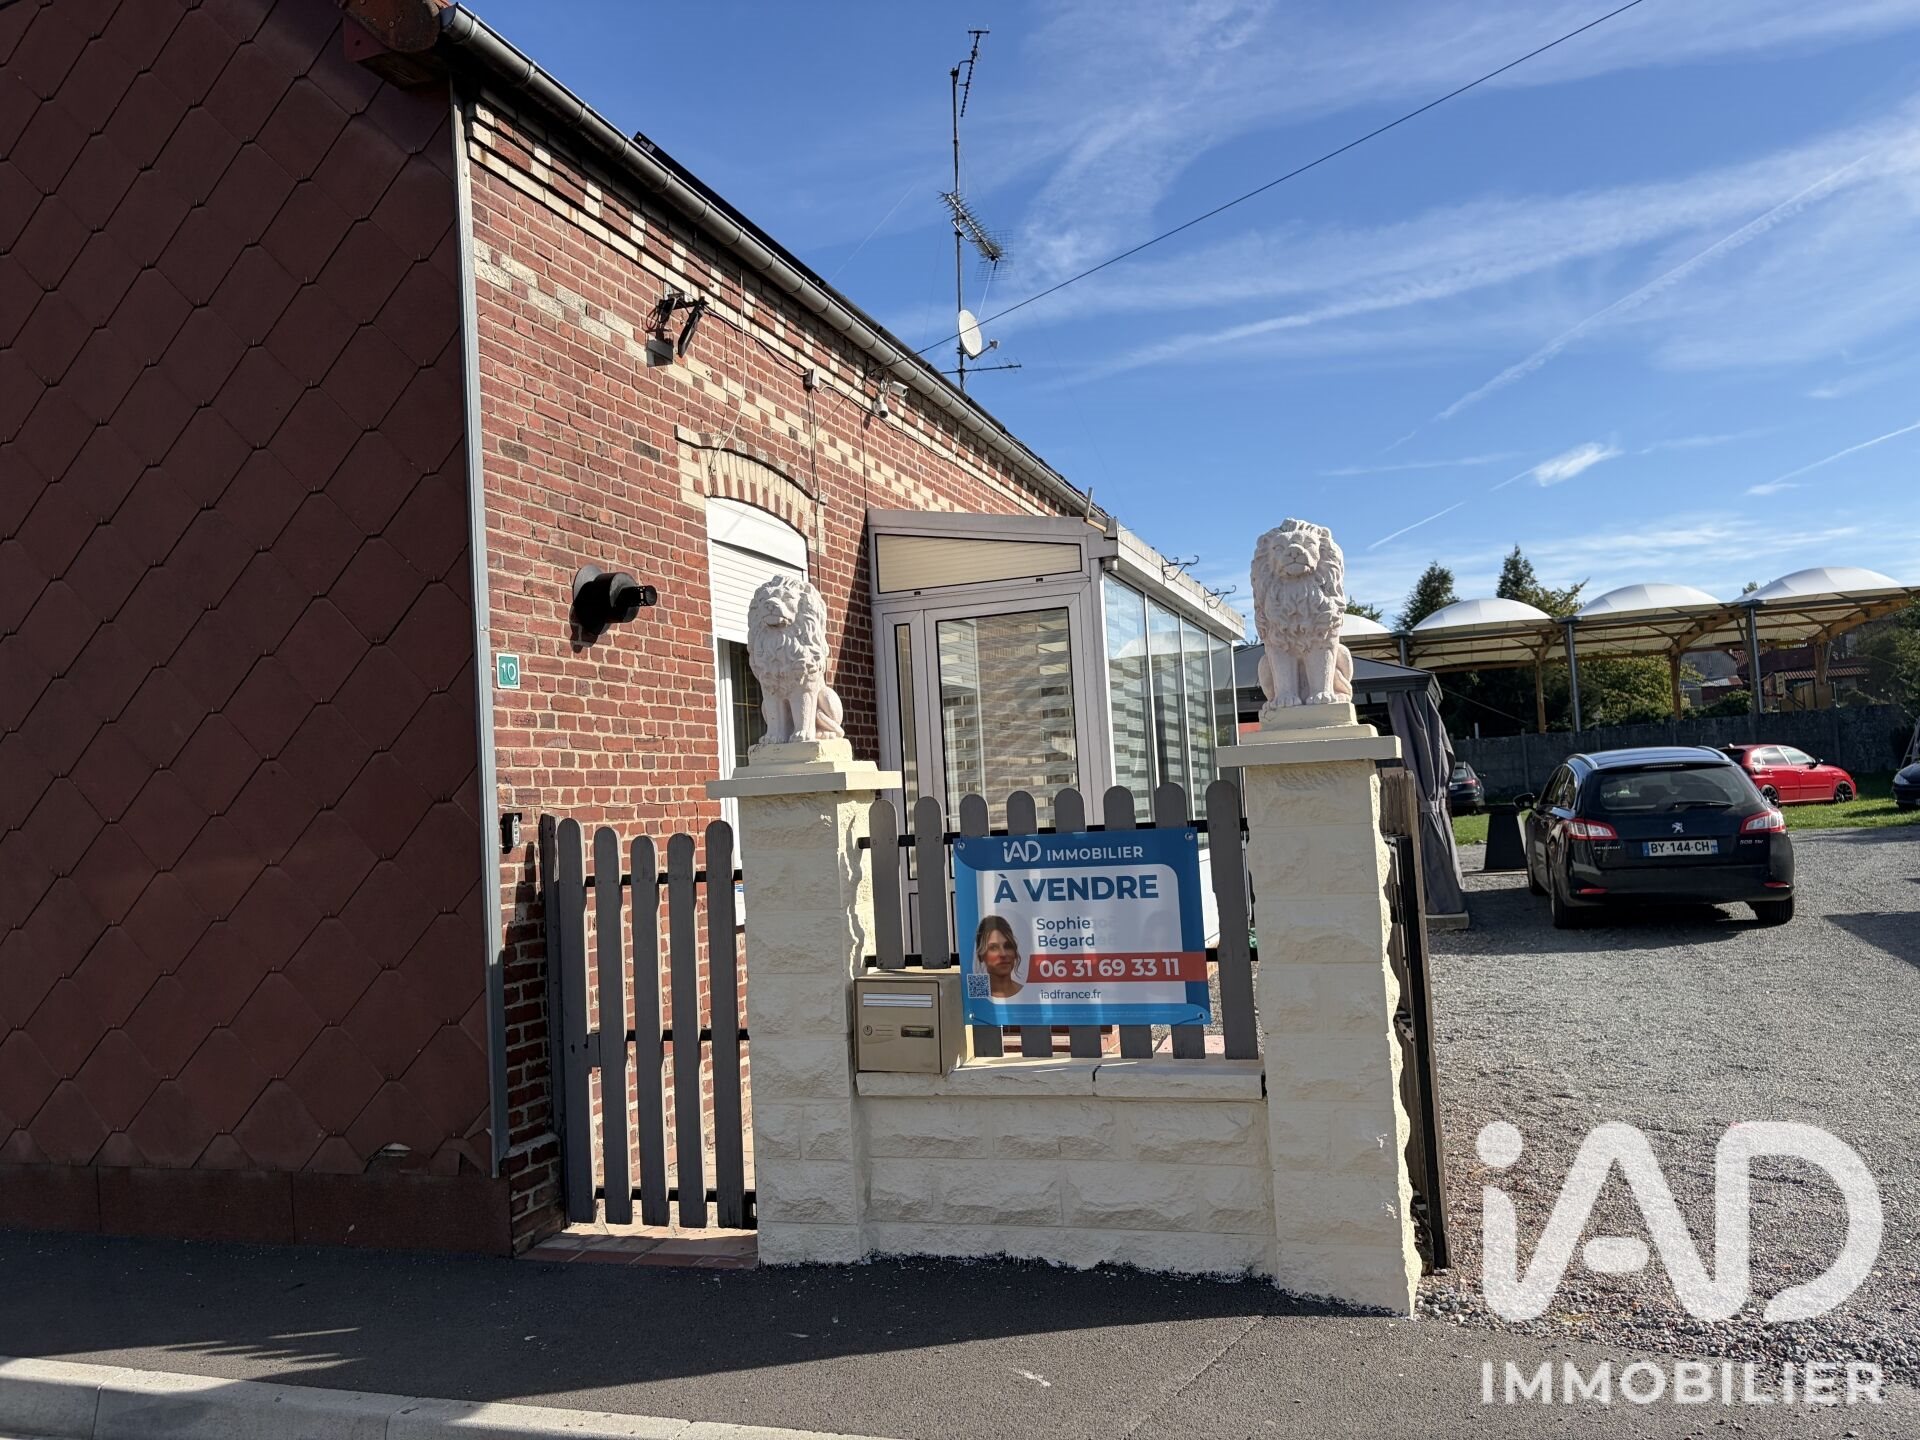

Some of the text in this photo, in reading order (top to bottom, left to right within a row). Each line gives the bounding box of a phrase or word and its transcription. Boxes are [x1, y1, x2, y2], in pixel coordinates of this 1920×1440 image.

[501, 662, 516, 681] 10
[1047, 846, 1144, 862] IMMOBILIER
[994, 874, 1159, 904] À VENDRE
[1036, 917, 1091, 934] Sophie
[1038, 934, 1095, 950] Bégard
[1039, 958, 1180, 978] 06 31 69 33 11
[1040, 989, 1102, 1000] iadfrance.fr
